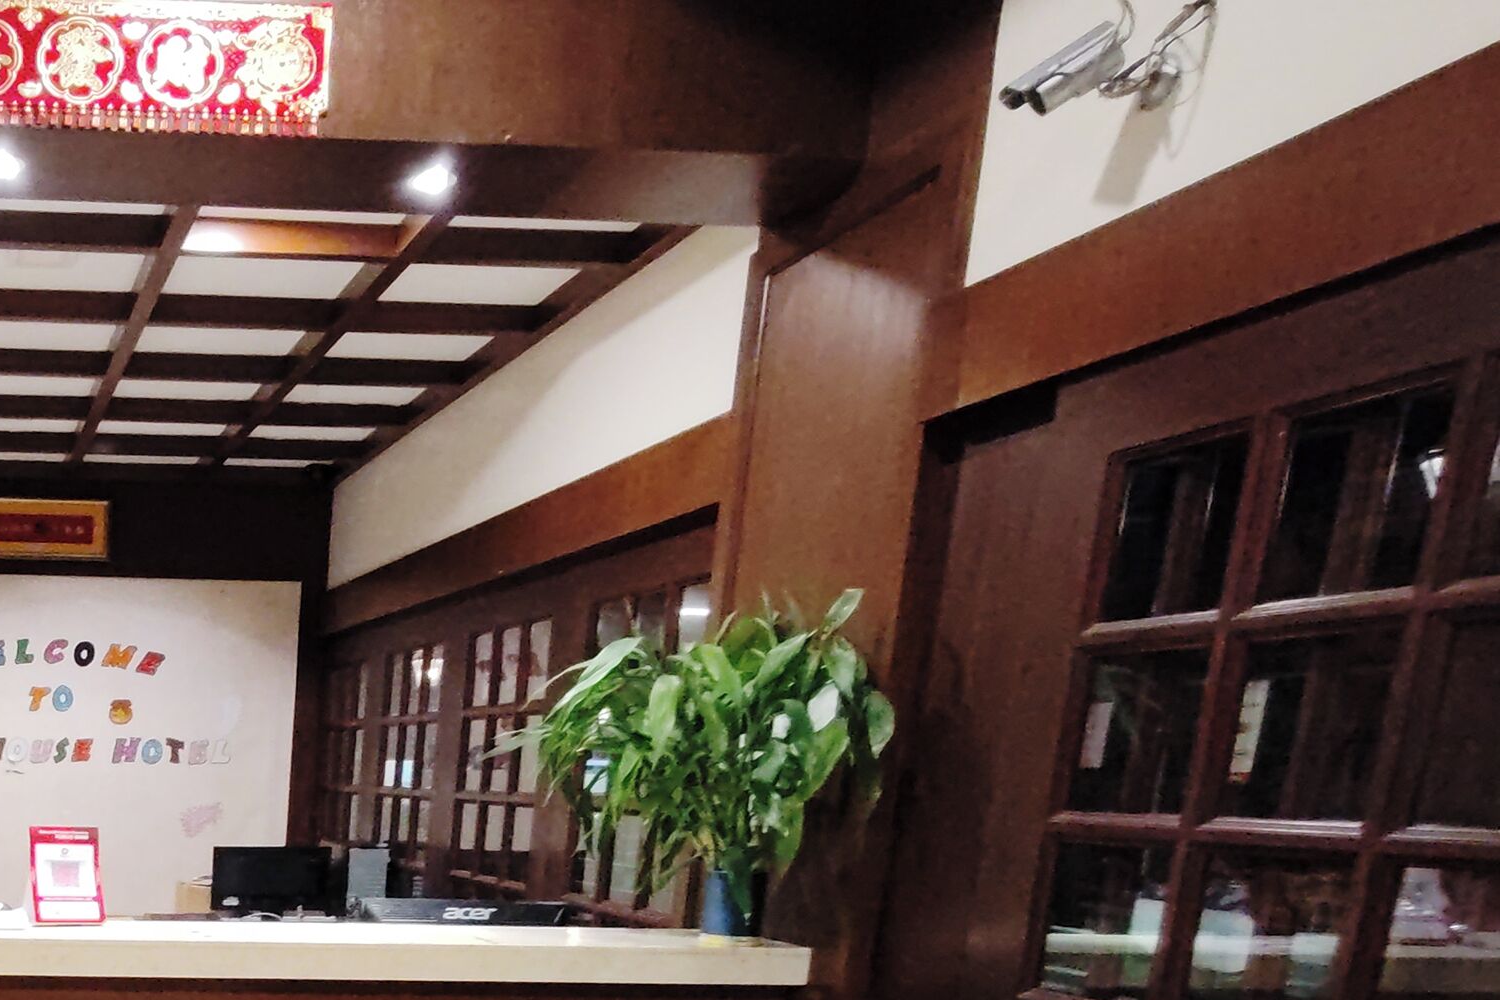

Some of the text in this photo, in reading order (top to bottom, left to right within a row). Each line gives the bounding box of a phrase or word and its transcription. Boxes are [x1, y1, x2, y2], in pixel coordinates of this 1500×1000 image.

[29, 684, 74, 712] TO
[111, 737, 231, 765] HOTEL
[442, 906, 498, 921] acer
